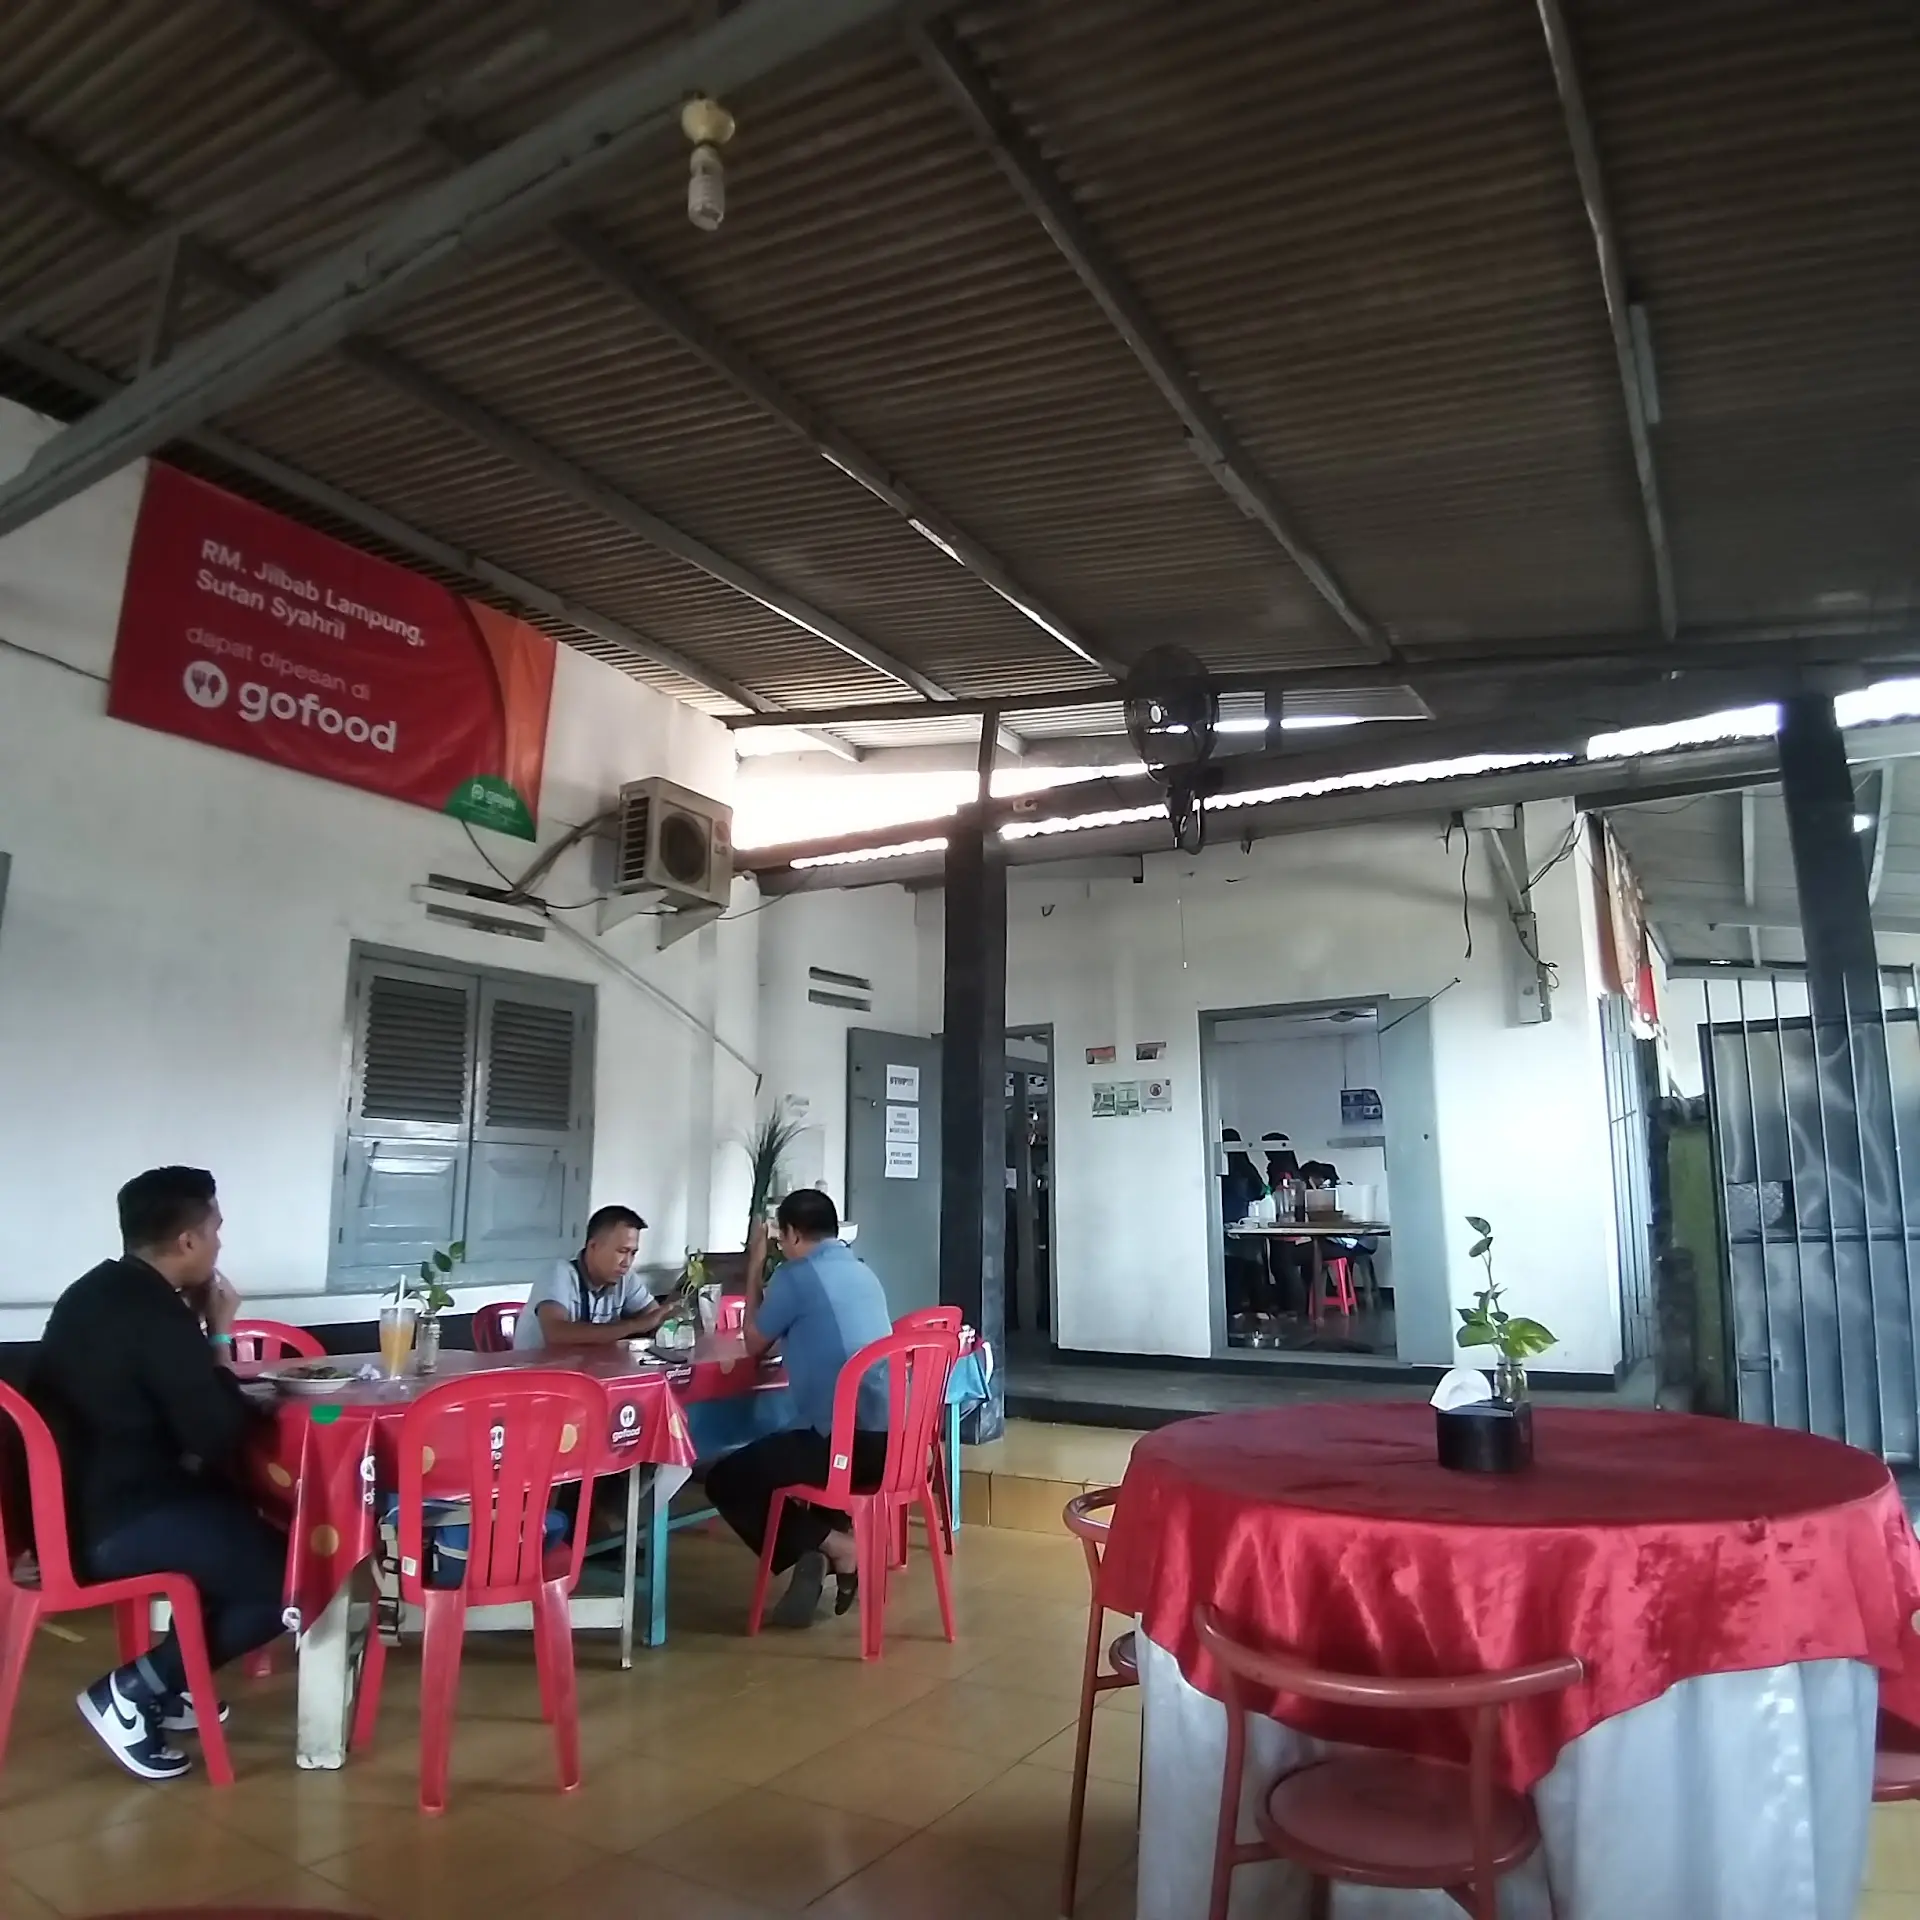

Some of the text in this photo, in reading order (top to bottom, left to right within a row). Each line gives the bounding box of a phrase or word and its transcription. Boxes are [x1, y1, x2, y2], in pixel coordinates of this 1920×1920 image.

[196, 568, 346, 641] Sutan Syahril
[202, 538, 247, 574] RM.
[254, 562, 320, 602] Jilbab
[185, 627, 371, 700] dapat dipesan di
[237, 681, 397, 753] gofood
[612, 1426, 641, 1442] gofood
